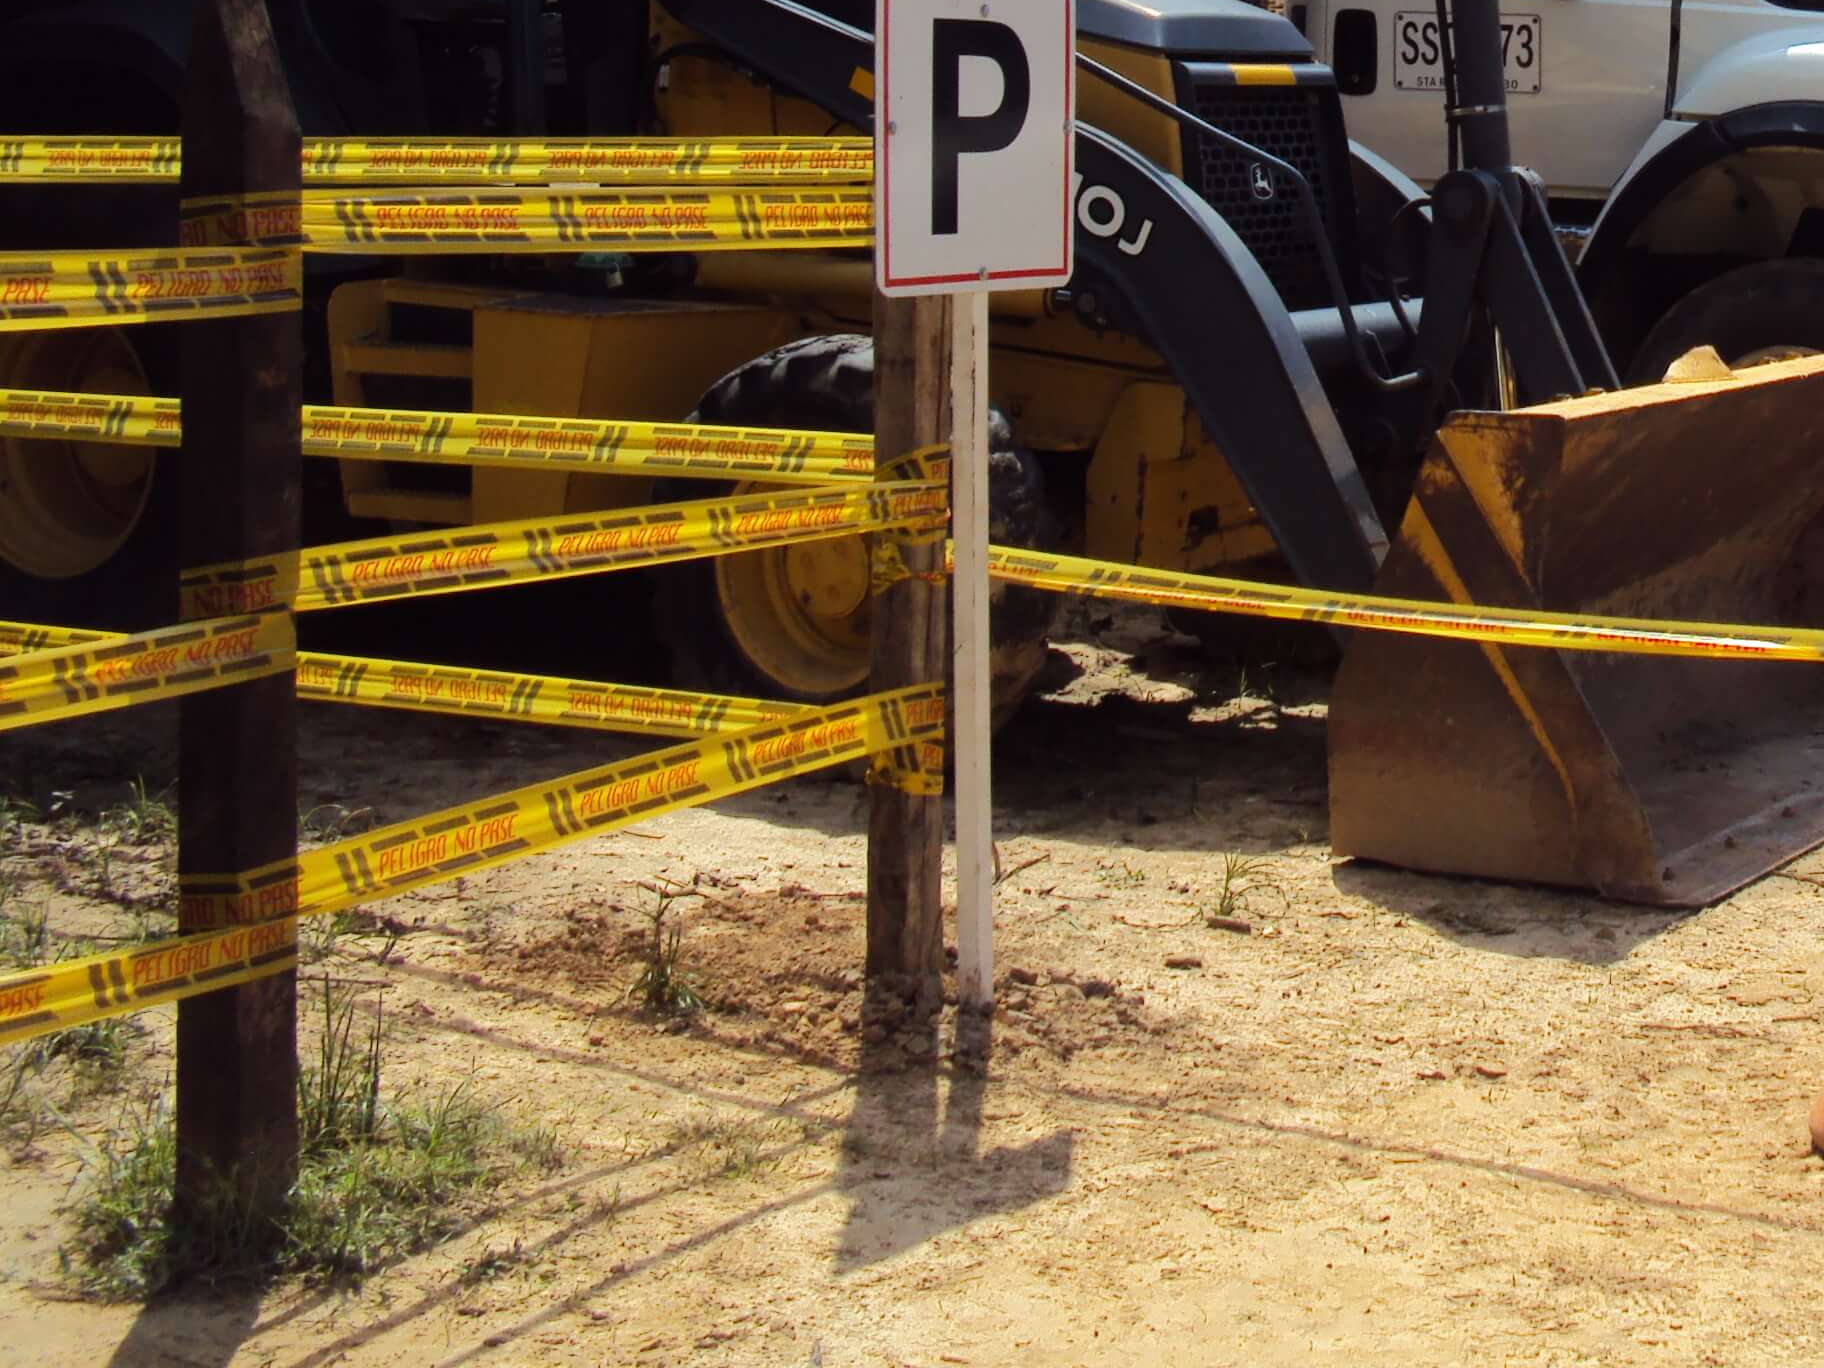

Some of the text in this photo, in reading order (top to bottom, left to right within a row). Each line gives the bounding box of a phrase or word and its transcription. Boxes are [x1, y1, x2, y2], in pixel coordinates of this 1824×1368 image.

[1401, 21, 1533, 68] SS73
[932, 18, 1030, 235] P
[376, 207, 521, 231] PELIGRO NO PASE
[585, 206, 709, 230] PELIGRO NO PASE
[3, 276, 50, 304] PASE
[132, 262, 288, 298] PELIGRO NO PASE
[736, 504, 845, 534] PELIGRO NO PASE
[557, 523, 685, 554] PELIGRO NO PASE
[352, 545, 497, 583] PELIGRO NO PASE
[752, 719, 860, 764] PELIGRO NO PASE
[580, 762, 701, 816] PELIGRO NO PASE
[378, 814, 520, 879] PELIGRO NO PASE
[132, 922, 289, 986] PELIGRO NO PASE
